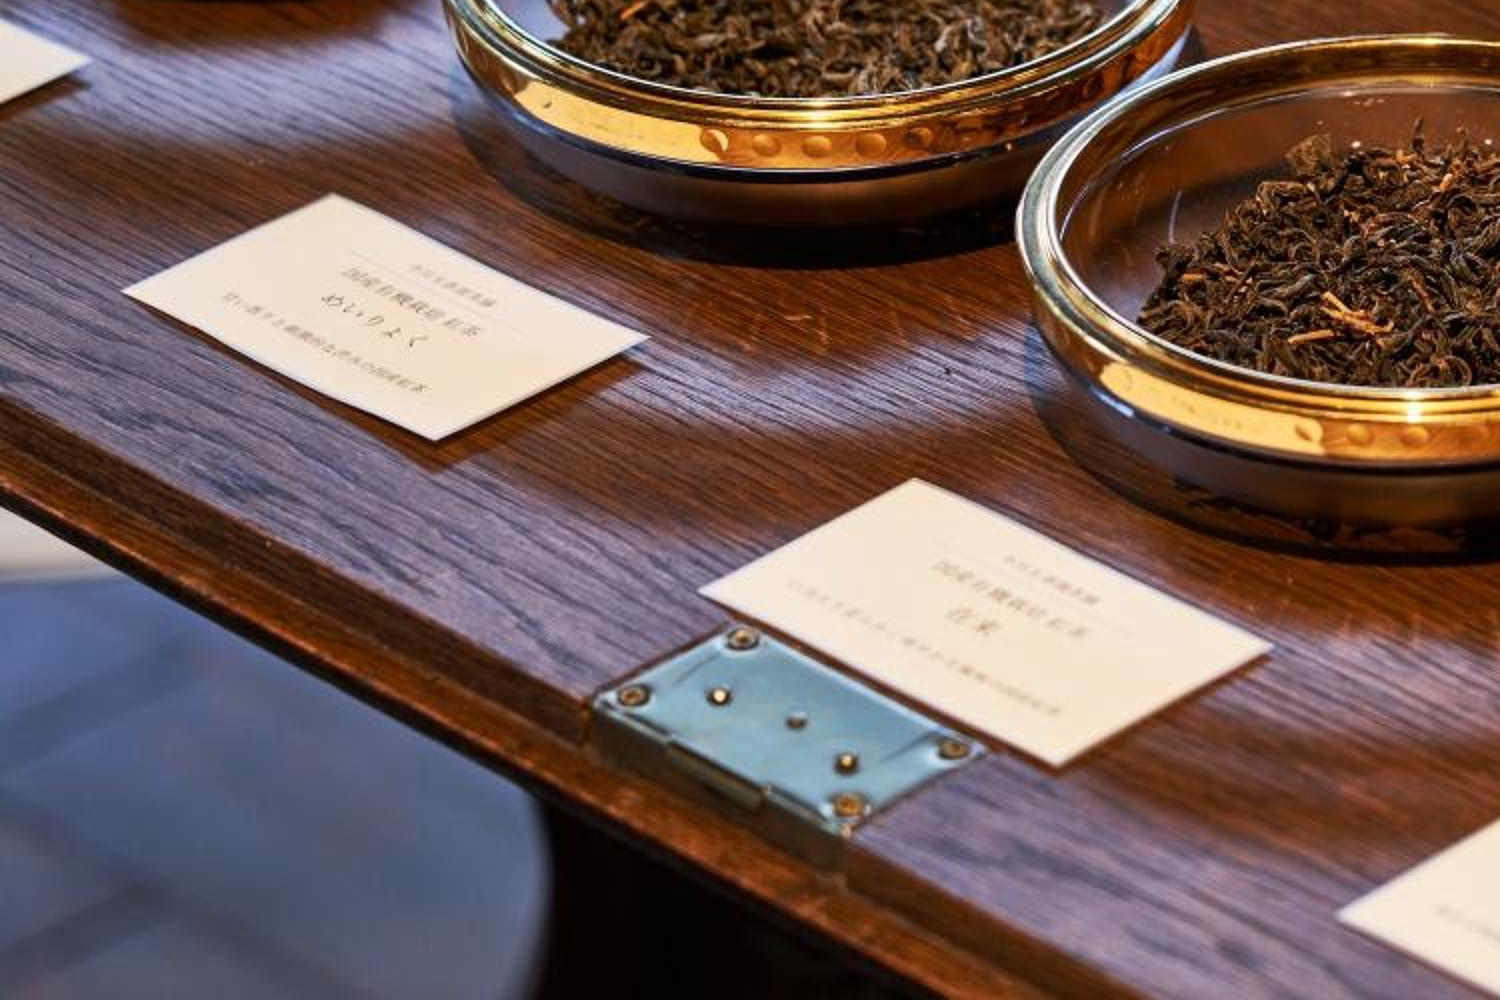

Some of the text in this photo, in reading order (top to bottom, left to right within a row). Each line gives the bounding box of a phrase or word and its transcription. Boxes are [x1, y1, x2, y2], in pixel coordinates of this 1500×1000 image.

[320, 294, 430, 348] めいりょく
